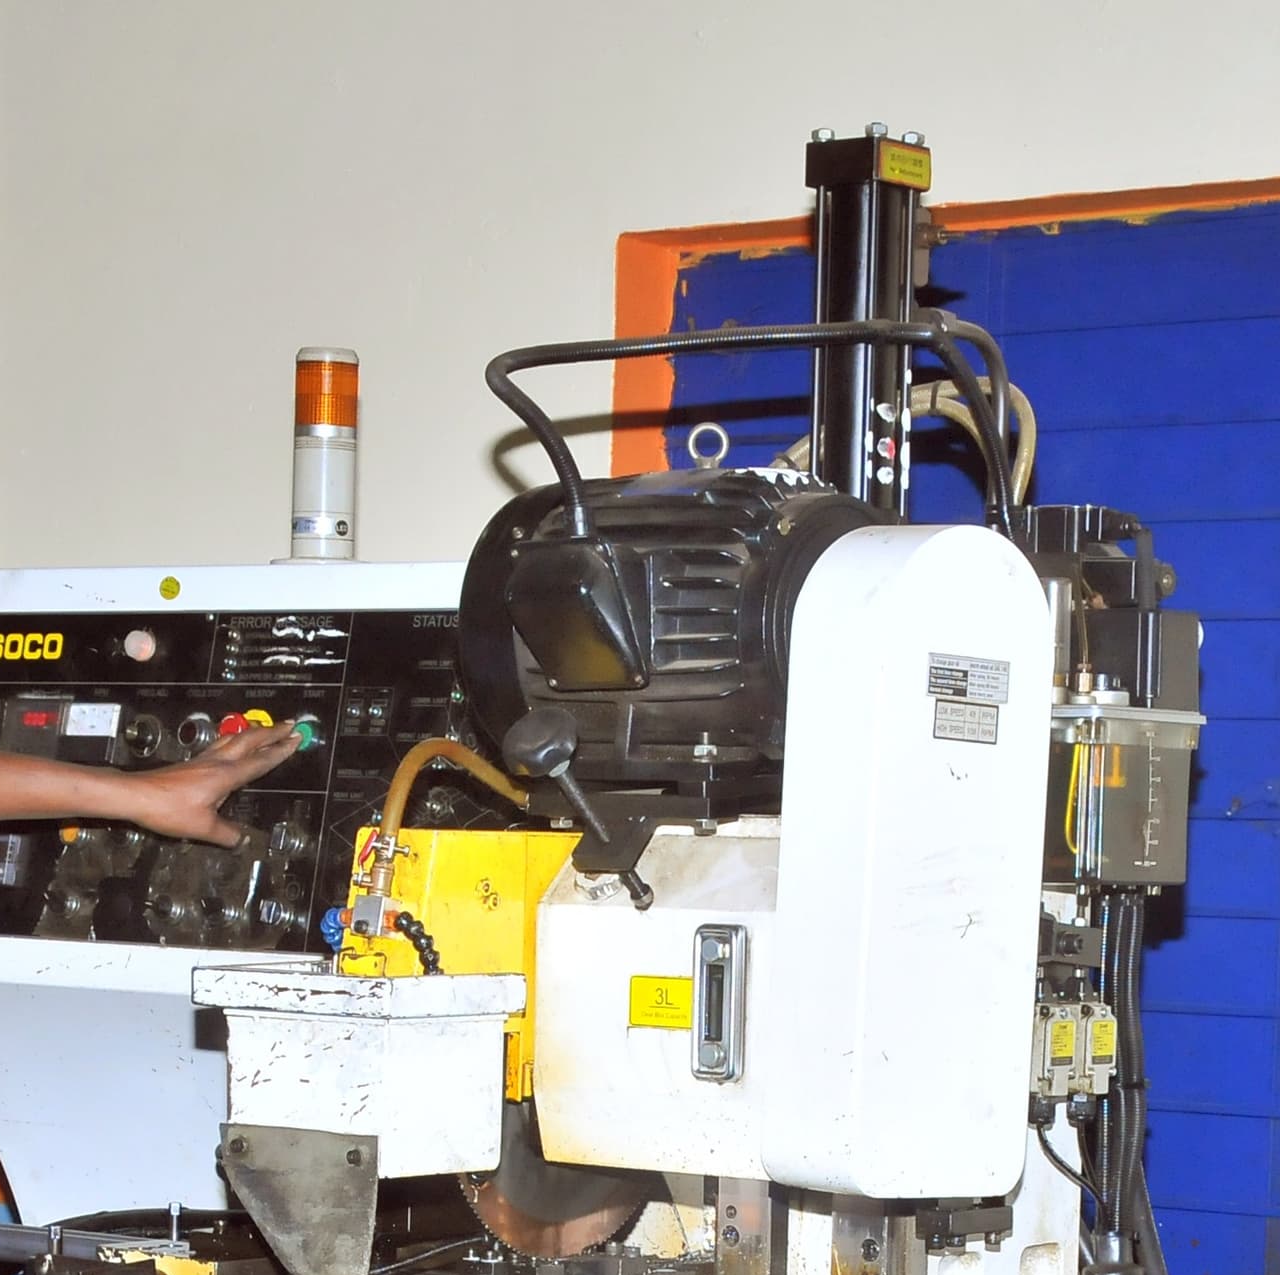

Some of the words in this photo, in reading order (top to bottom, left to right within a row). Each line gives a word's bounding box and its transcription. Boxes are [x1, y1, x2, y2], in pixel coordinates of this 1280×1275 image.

[230, 616, 272, 628] ERROR
[412, 615, 460, 628] STATUS
[655, 987, 673, 1005] 3L
